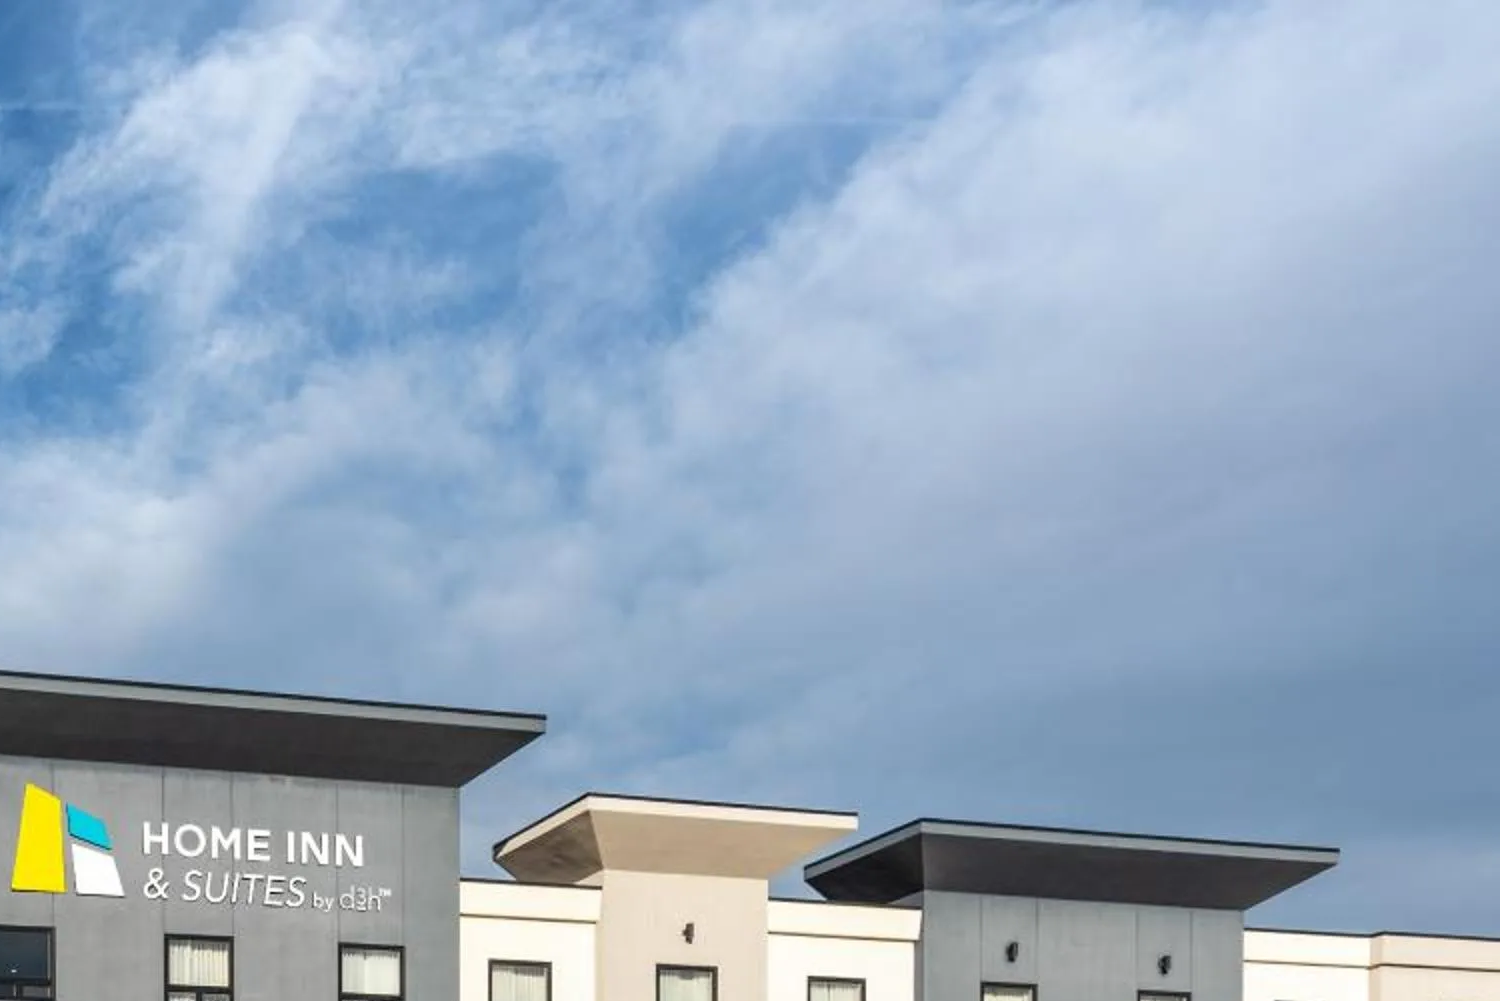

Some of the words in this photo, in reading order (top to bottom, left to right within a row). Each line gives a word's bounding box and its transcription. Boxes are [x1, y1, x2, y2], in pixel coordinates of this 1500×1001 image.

[142, 821, 271, 861] HOME
[286, 831, 364, 867] INN
[143, 867, 170, 900] &
[182, 869, 307, 908] SUITES
[312, 891, 334, 913] by
